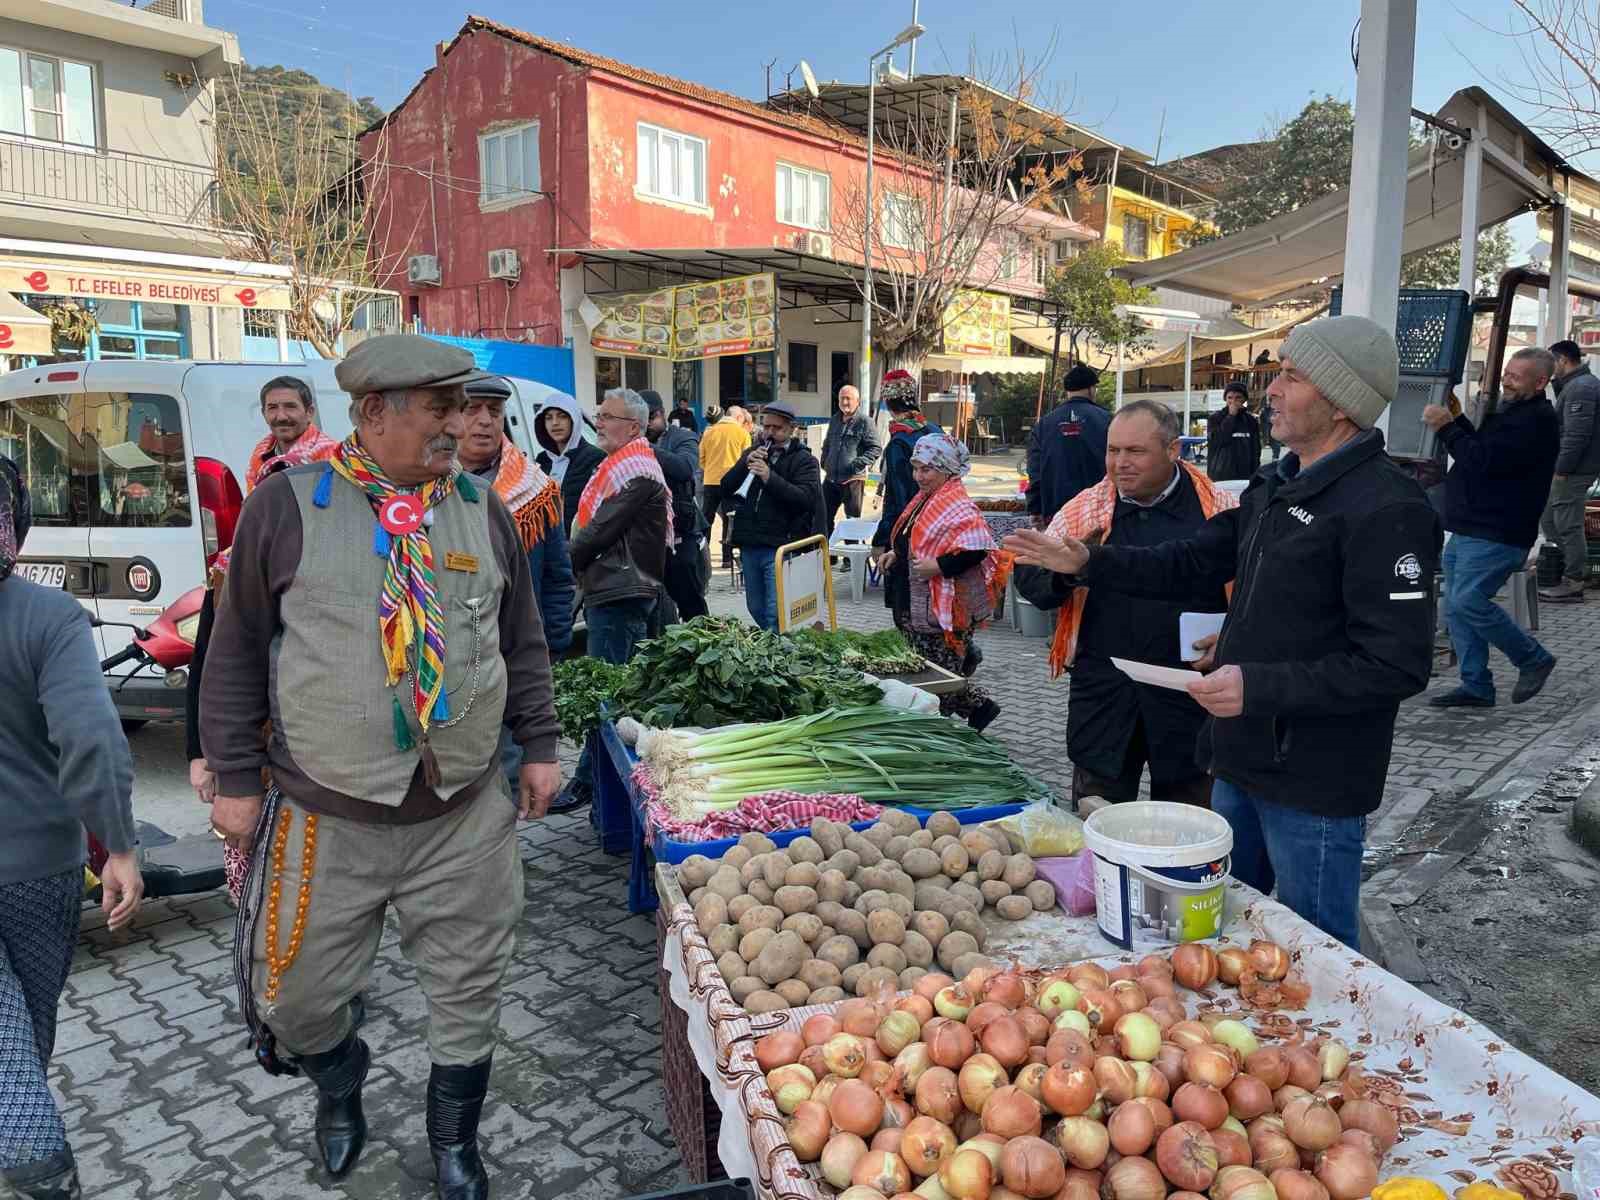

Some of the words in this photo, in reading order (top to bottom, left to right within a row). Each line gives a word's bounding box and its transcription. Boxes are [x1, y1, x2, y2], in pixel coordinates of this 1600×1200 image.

[67, 277, 90, 293] T.C.
[93, 280, 142, 297] EFELER
[149, 284, 220, 303] BELEDİYESİ
[39, 566, 65, 585] 719
[134, 572, 147, 585] FIAT
